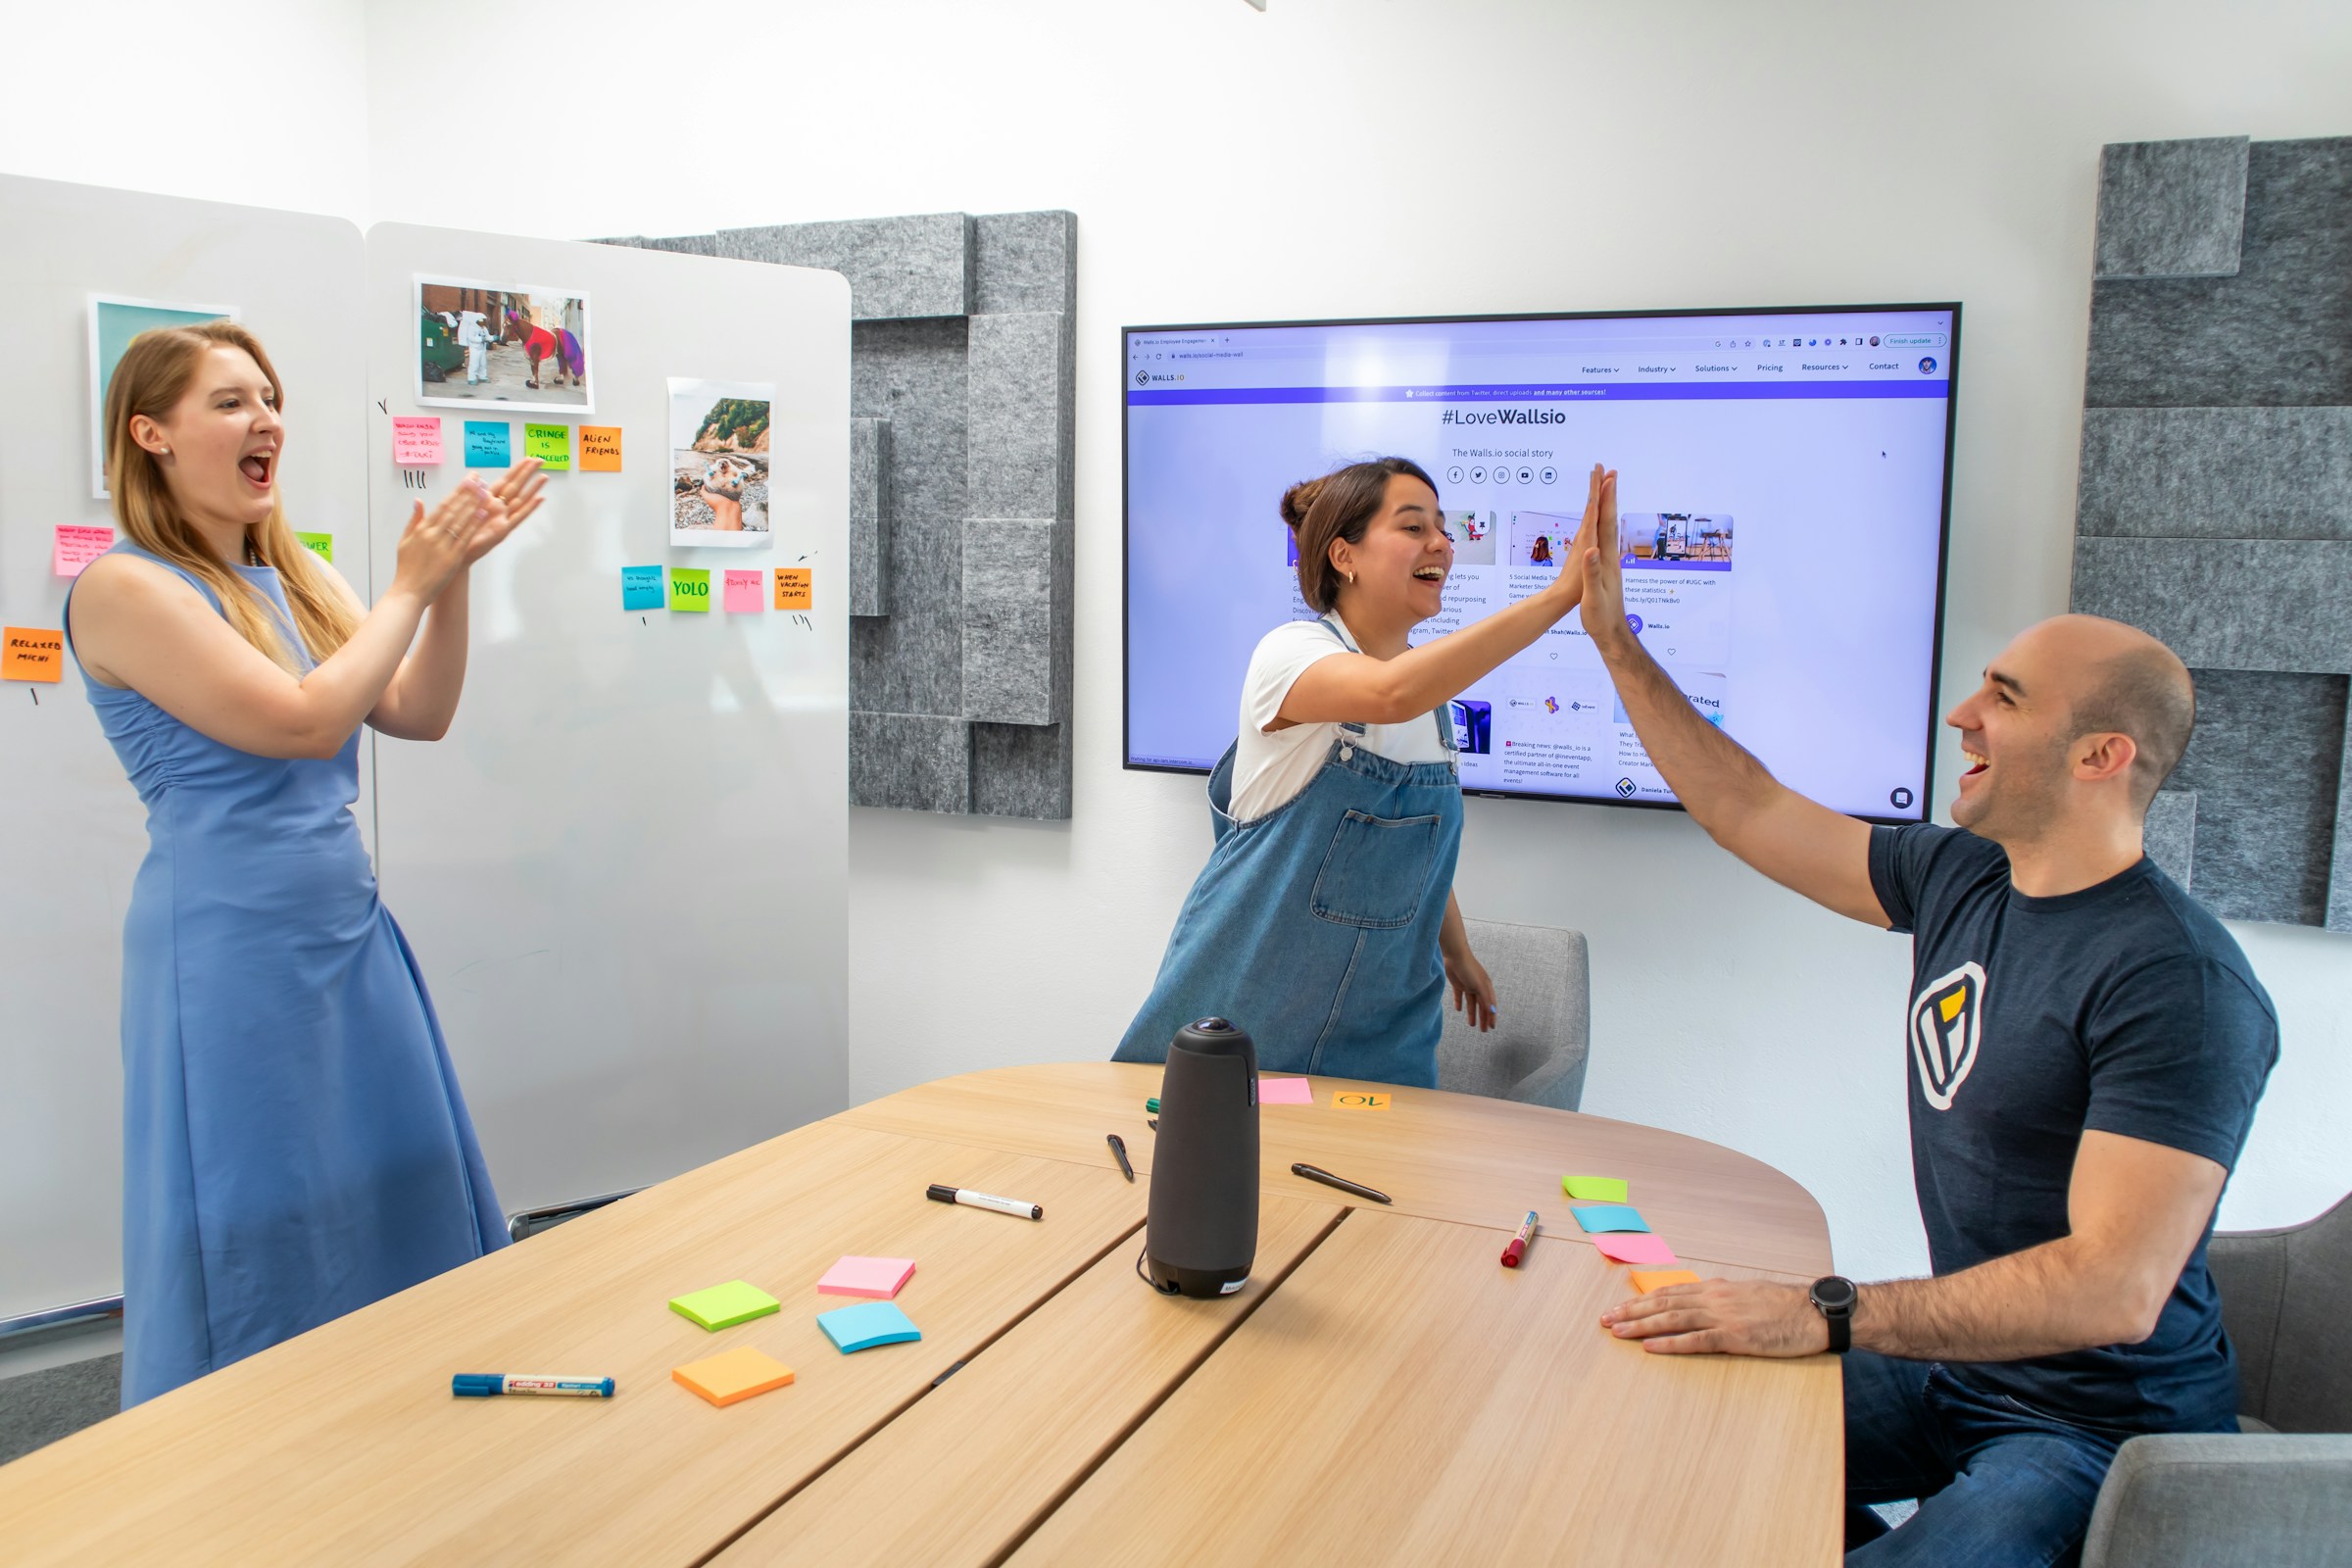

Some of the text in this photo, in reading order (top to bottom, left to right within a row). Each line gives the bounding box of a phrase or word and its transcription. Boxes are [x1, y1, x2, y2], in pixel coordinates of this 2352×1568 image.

[1757, 364, 1784, 372] Pricing
[1442, 409, 1566, 425] #LoveWallsio
[528, 429, 565, 439] CRINGE
[586, 447, 619, 456] FRIENDS
[1452, 448, 1553, 459] The Walls.io social story
[673, 581, 709, 596] YOLO
[11, 639, 61, 650] RELAXED
